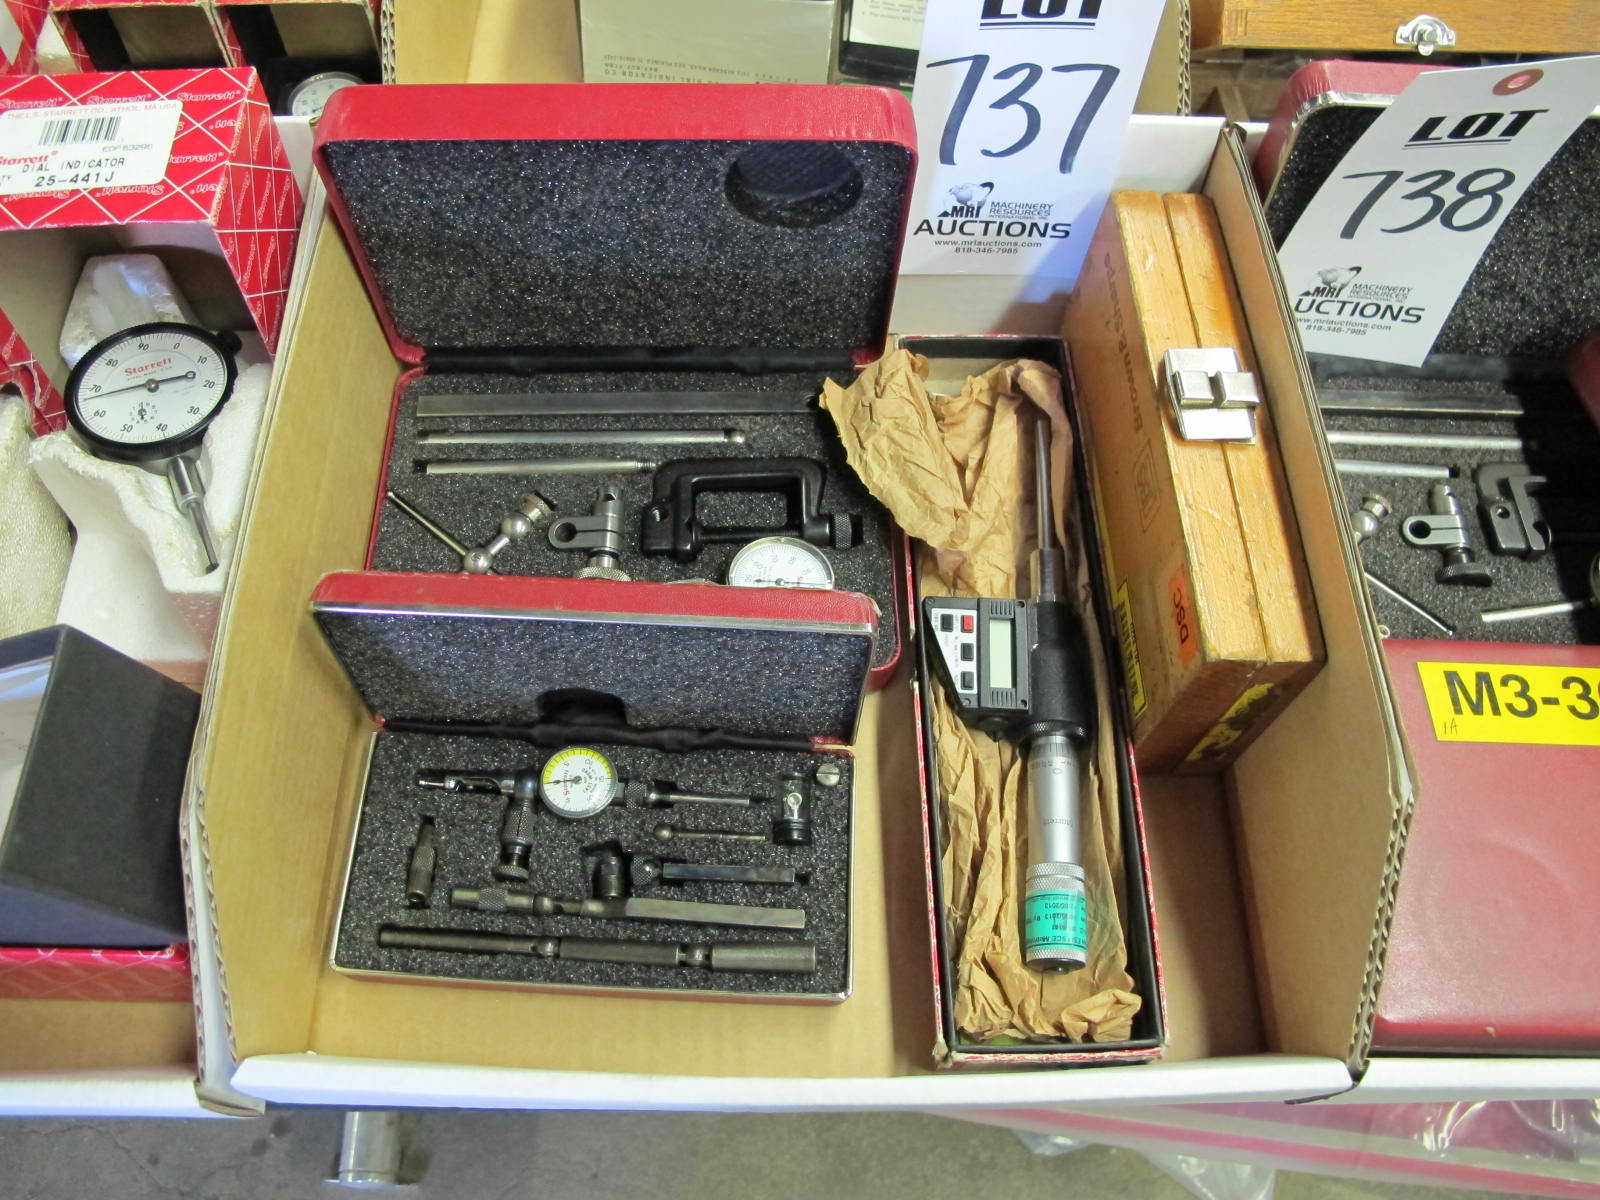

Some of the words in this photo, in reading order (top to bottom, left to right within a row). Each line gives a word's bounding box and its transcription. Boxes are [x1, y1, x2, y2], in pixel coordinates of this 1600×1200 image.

[926, 54, 1120, 175] 737
[1408, 109, 1549, 142] LOT
[22, 163, 51, 173] DIAL
[60, 157, 126, 171] INDICATOR
[34, 171, 116, 188] 25-441J
[990, 201, 1054, 211] MACHINERY
[1339, 167, 1516, 240] 738
[949, 205, 982, 218] MRI
[989, 207, 1052, 218] RESOURCES
[913, 219, 1072, 239] AUCTIONS
[954, 246, 1018, 255] 818-346-7985
[1102, 253, 1124, 334] Sharpe
[1310, 286, 1343, 299] MRI
[1352, 283, 1414, 294] MACHINERY
[1349, 289, 1410, 300] RESOURCES
[138, 343, 149, 352] 90
[173, 342, 181, 350] 0
[105, 358, 119, 368] 80
[197, 355, 208, 365] 10
[124, 357, 172, 376] Starrett
[89, 384, 102, 393] 70
[203, 380, 215, 389] 20
[1121, 352, 1144, 434] Brown
[93, 409, 106, 418] 60
[187, 406, 200, 415] 30
[120, 424, 134, 433] 50
[155, 423, 168, 432] 40
[1172, 586, 1190, 645] DSC
